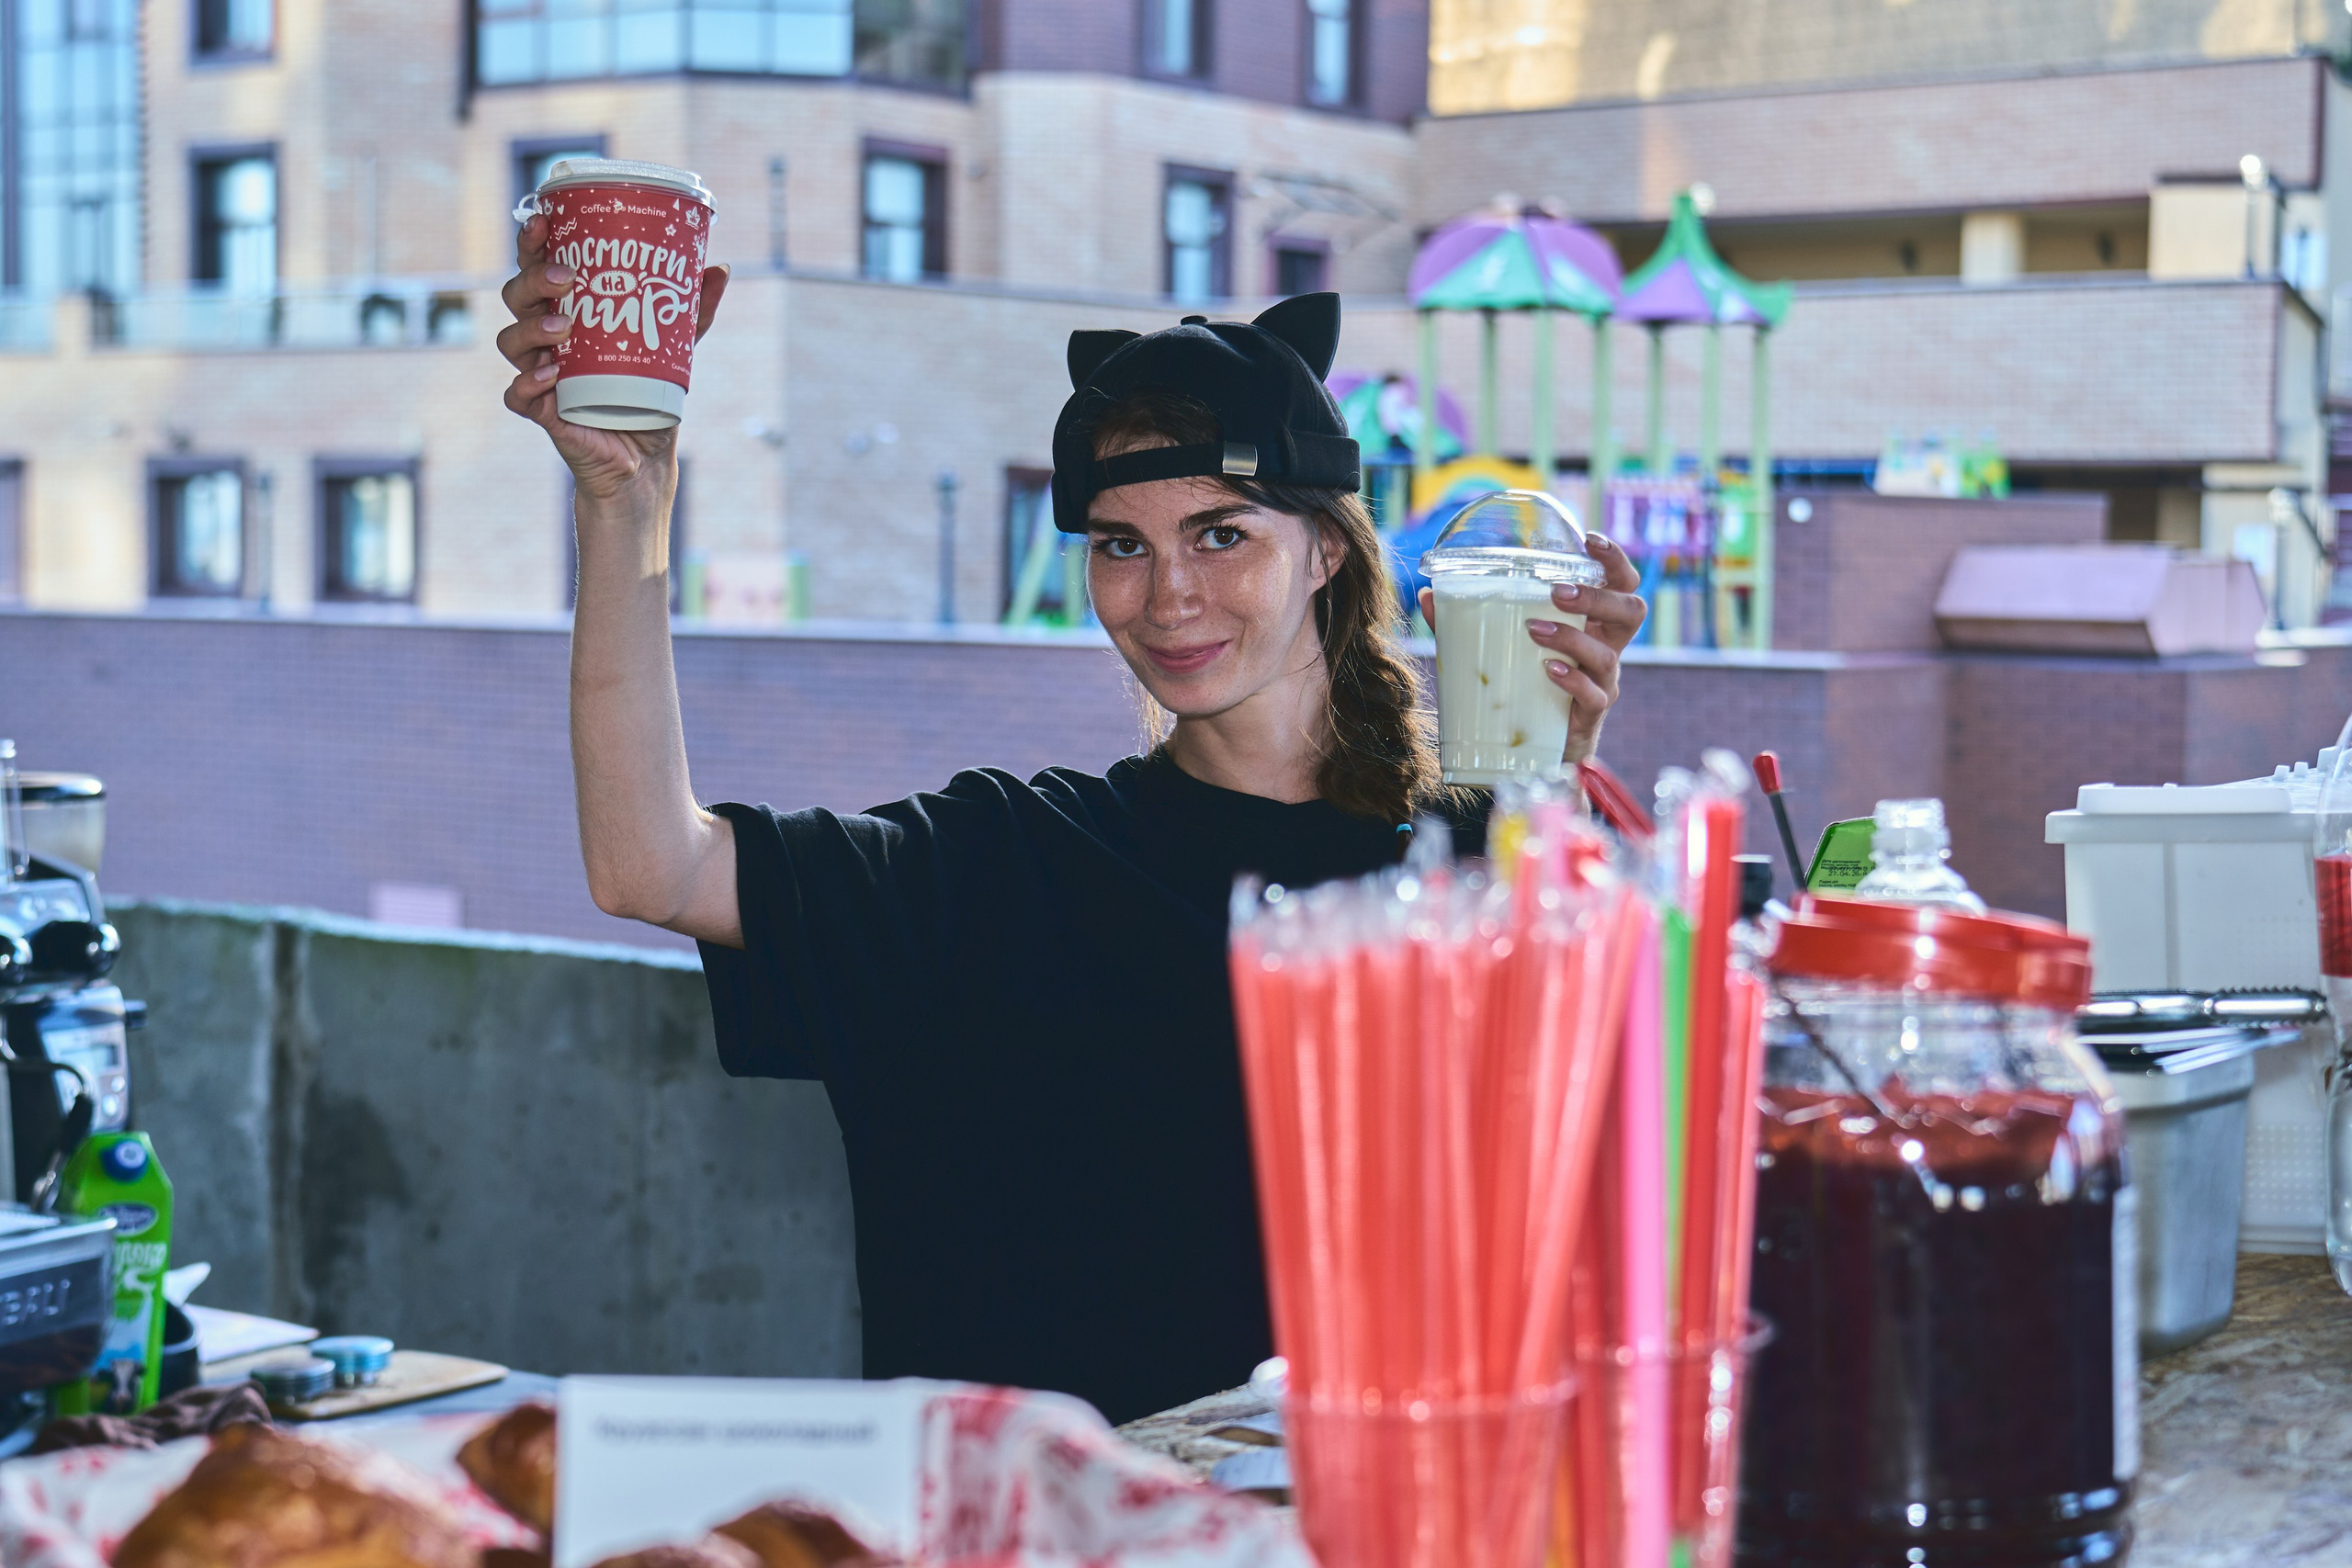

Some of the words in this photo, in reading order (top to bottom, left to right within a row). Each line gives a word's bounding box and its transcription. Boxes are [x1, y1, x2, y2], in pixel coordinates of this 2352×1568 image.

[581, 203, 612, 214] Coffee
[628, 205, 667, 218] Machine
[555, 237, 687, 283] ПОСМОТРИ
[601, 275, 627, 292] на
[632, 355, 641, 364] 45
[642, 356, 651, 365] 40
